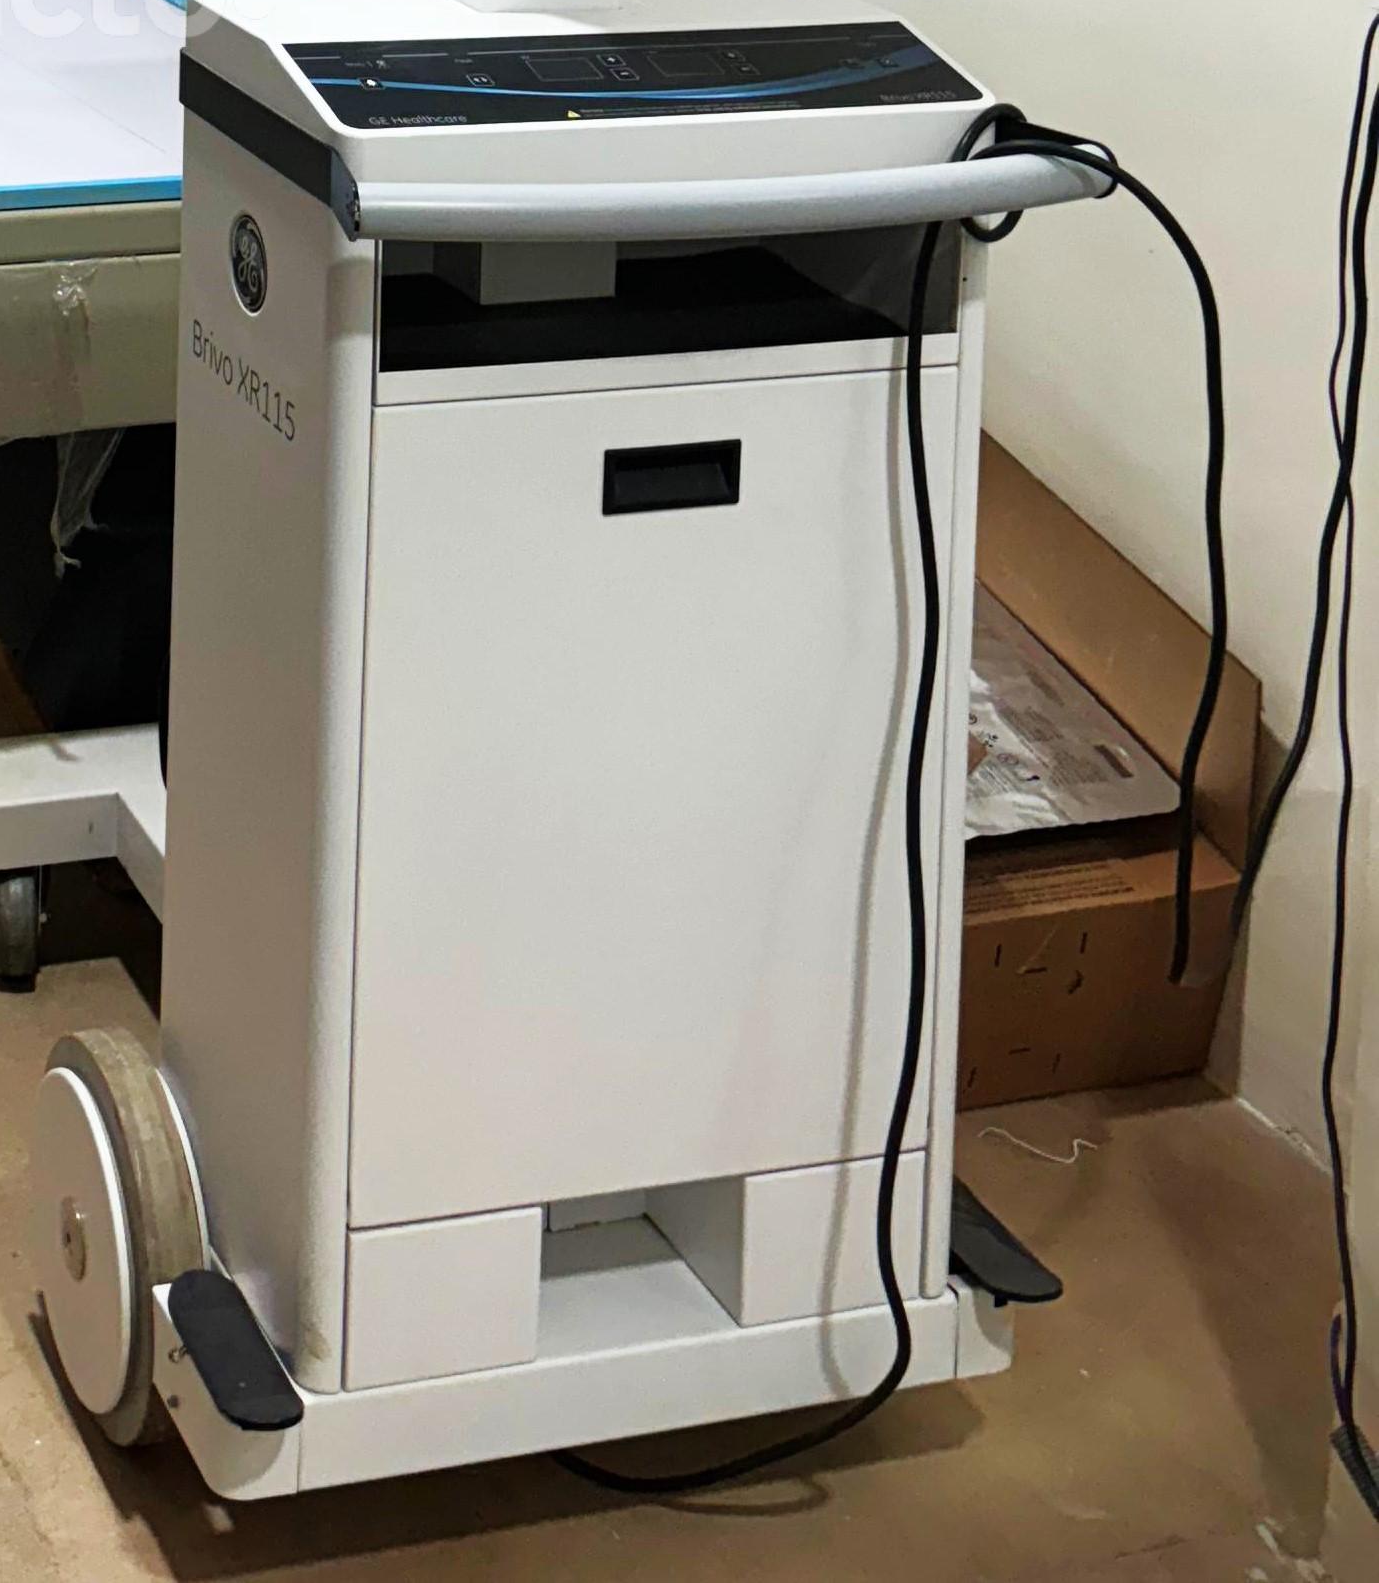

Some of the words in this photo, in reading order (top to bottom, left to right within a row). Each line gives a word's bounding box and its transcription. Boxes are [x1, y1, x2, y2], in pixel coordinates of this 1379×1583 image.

[368, 116, 389, 126] GE
[391, 115, 468, 125] Healthcare
[192, 319, 233, 386] Brivo
[237, 356, 296, 442] XR115
